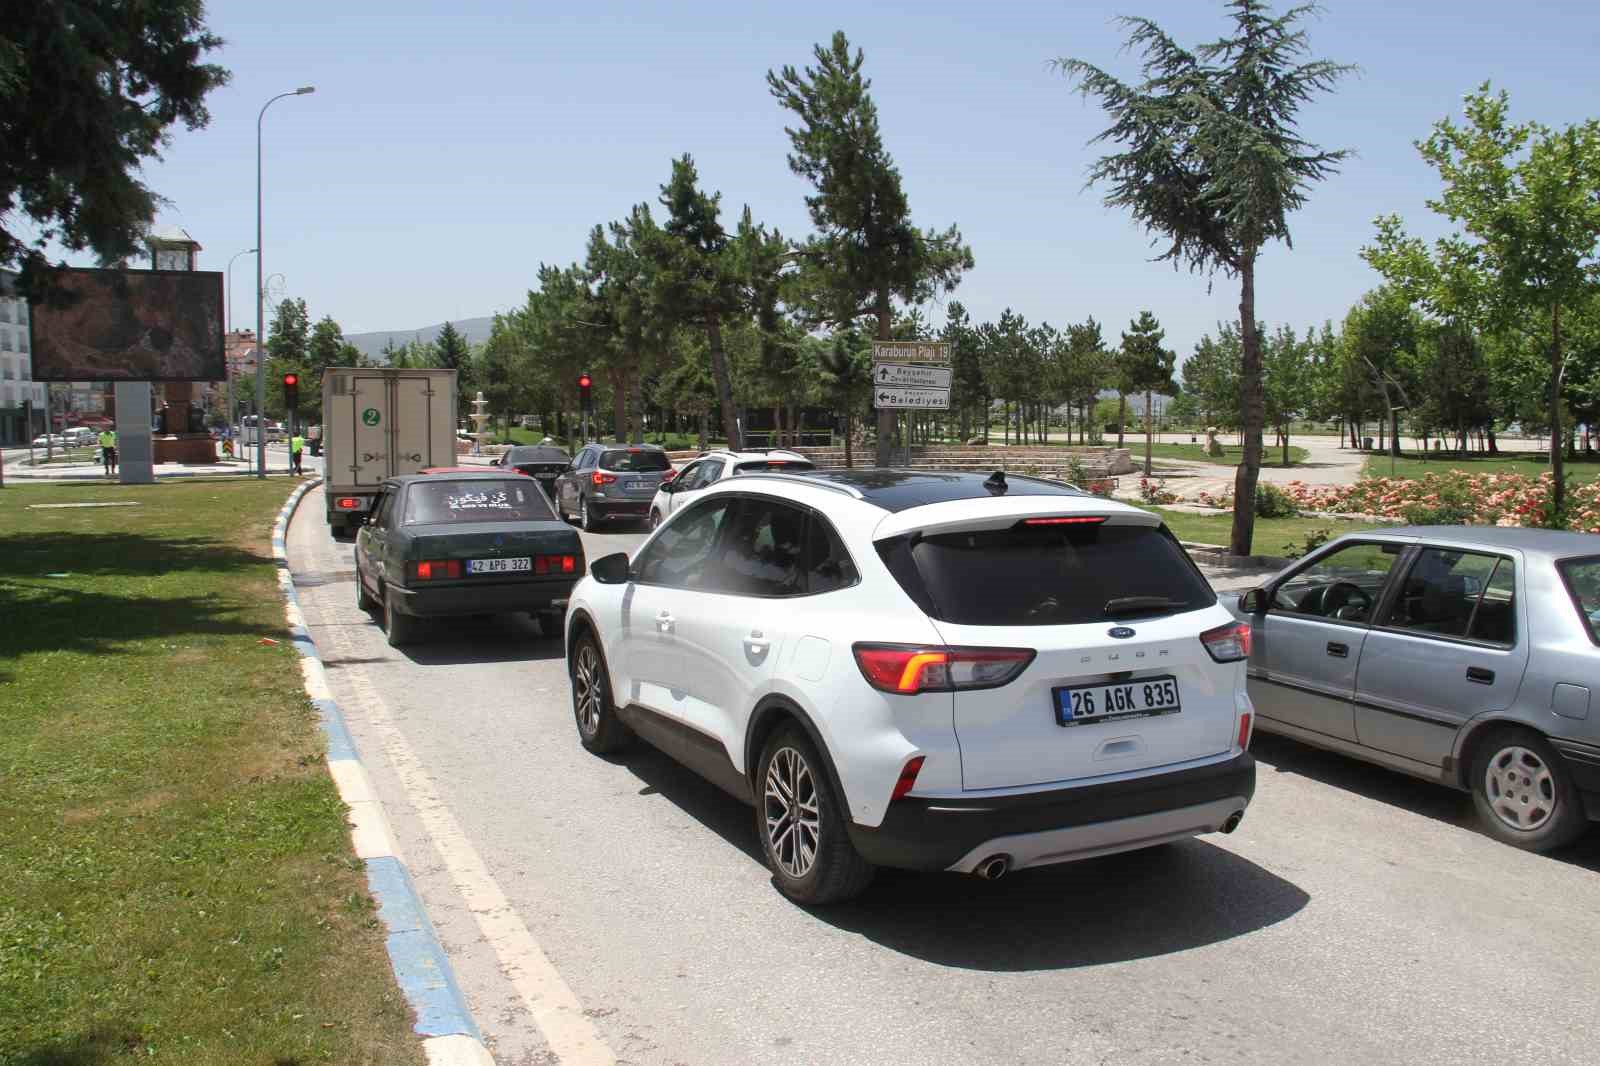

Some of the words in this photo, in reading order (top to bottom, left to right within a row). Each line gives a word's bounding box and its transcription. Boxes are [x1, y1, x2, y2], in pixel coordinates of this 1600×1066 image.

[367, 409, 377, 425] 2
[472, 560, 484, 571] 42
[511, 558, 529, 570] 322
[1072, 690, 1095, 716] 26
[1105, 686, 1136, 713] AGK
[1143, 682, 1175, 707] 835
